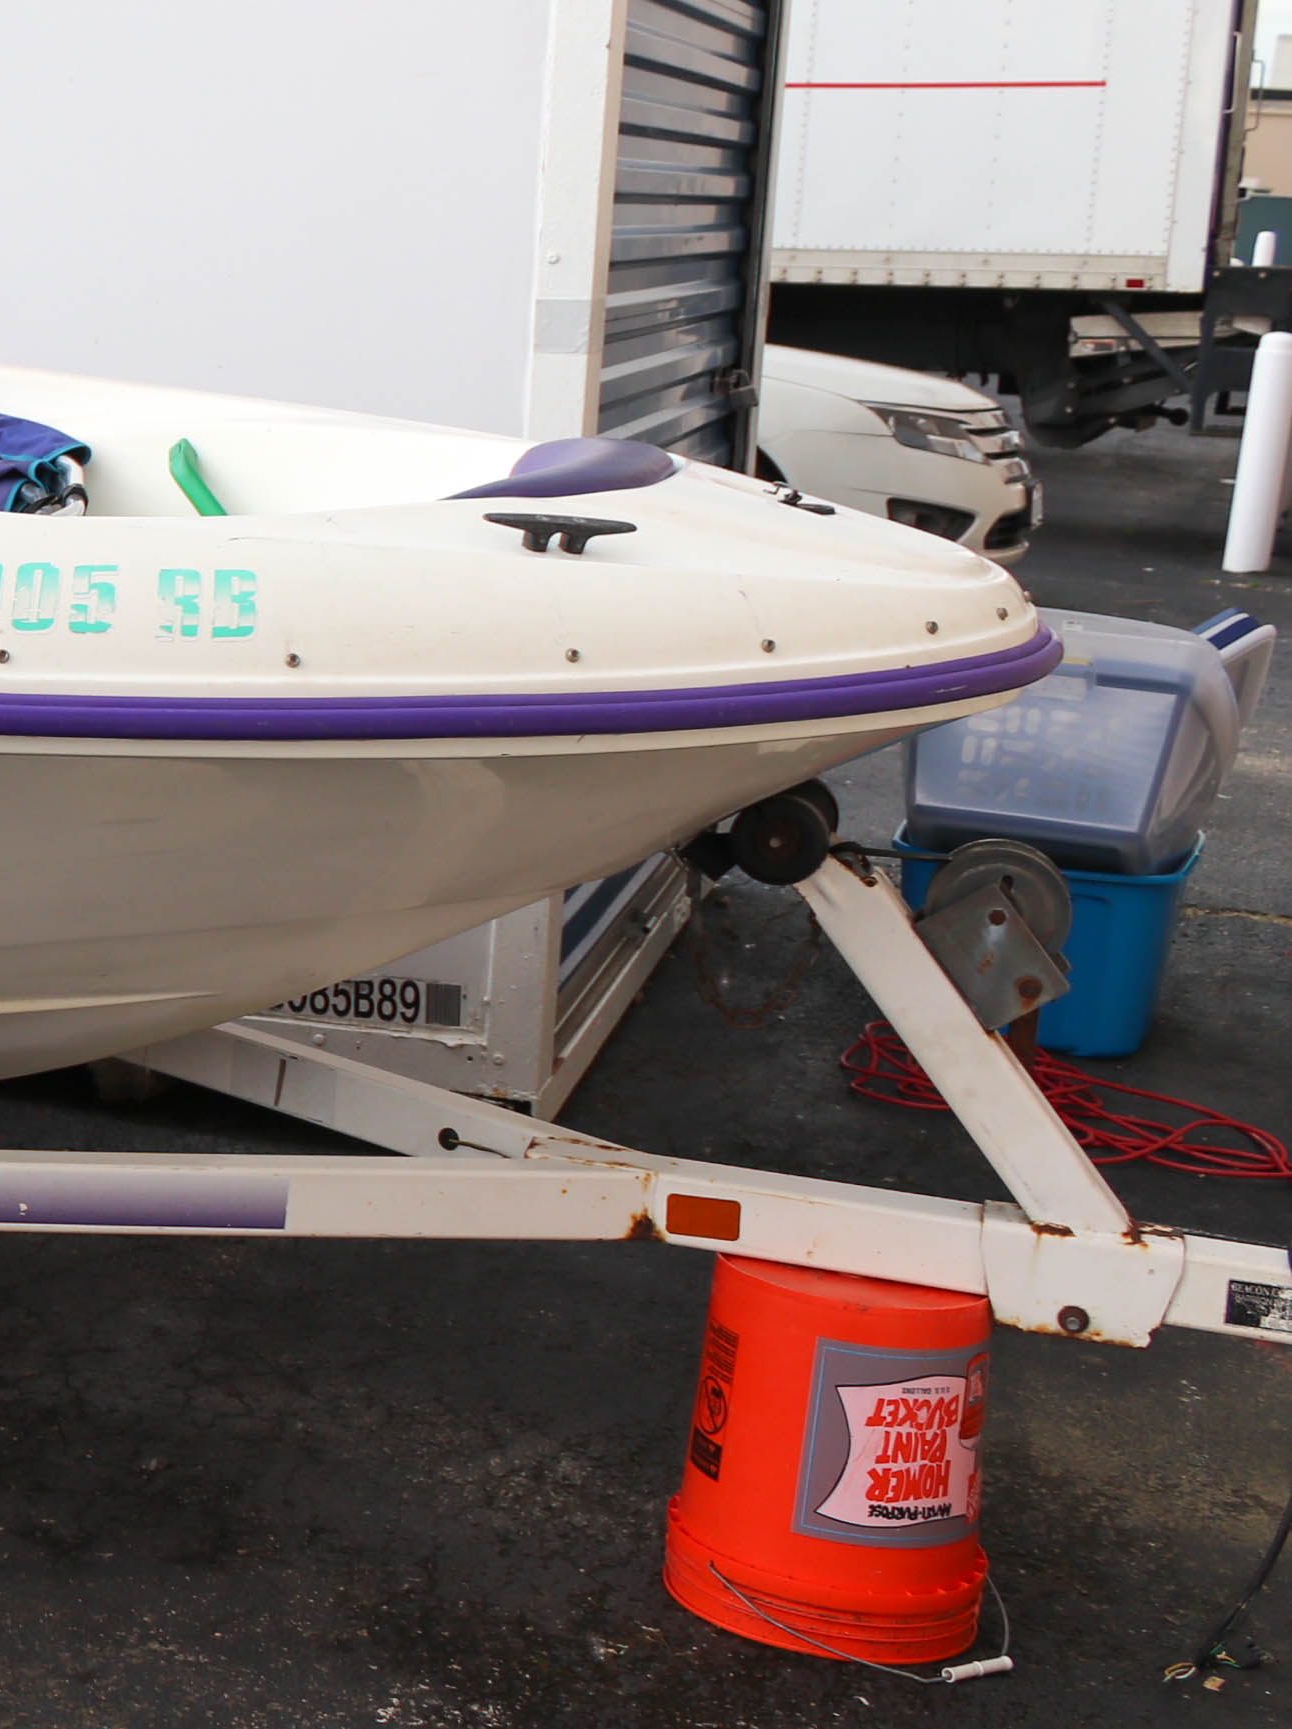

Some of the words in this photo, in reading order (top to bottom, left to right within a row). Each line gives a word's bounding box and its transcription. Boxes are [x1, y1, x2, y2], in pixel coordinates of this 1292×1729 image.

[864, 1394, 959, 1432] BUCKET
[875, 1429, 947, 1464] PAINT
[865, 1460, 951, 1503] HOMER
